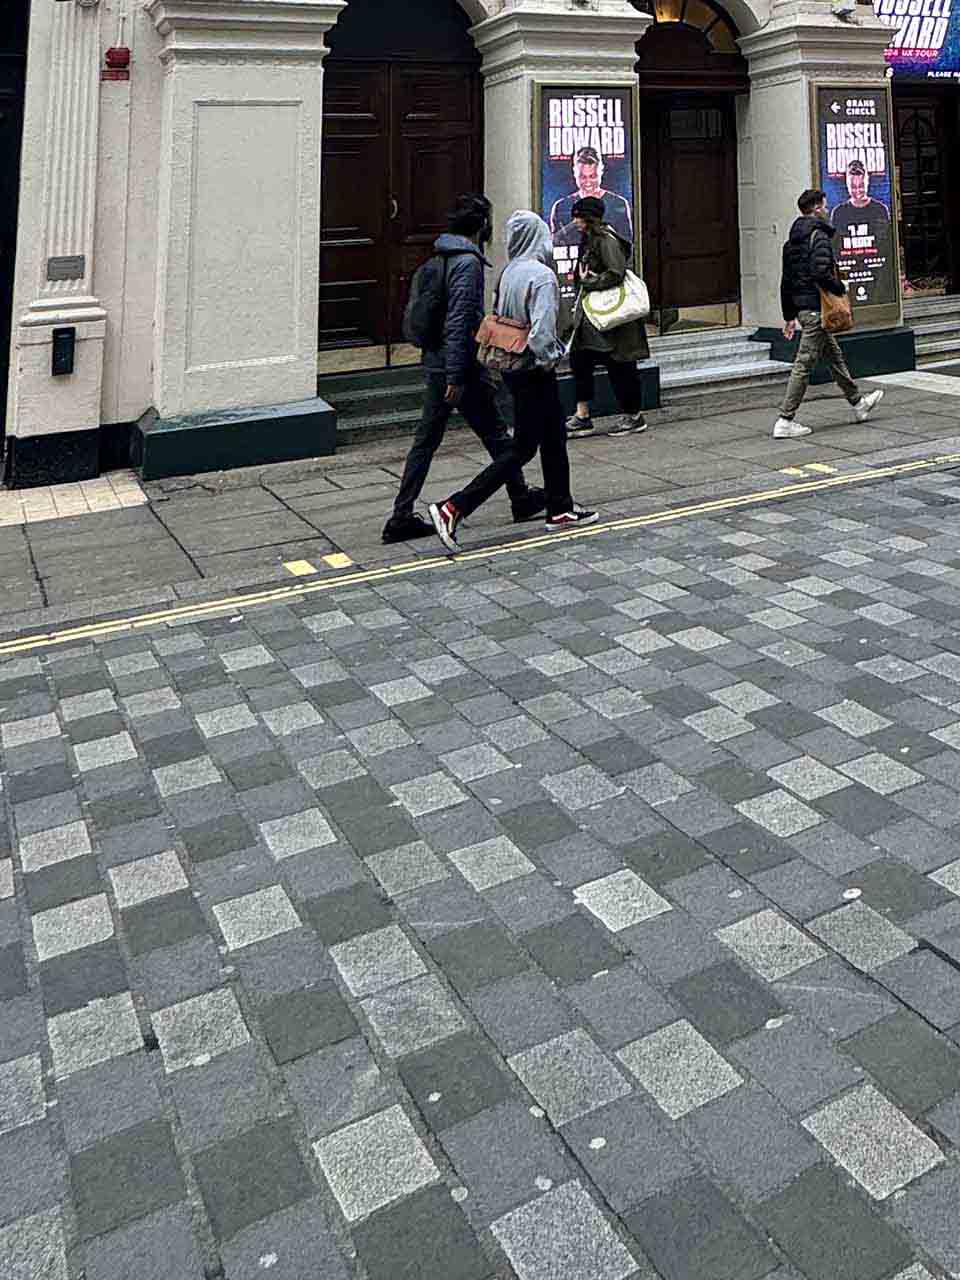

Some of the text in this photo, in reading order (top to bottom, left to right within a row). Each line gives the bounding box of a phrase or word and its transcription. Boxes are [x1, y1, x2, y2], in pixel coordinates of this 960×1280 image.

[549, 98, 625, 127] RUSSELL
[846, 99, 875, 107] GRAND
[846, 107, 876, 116] CIRCLE
[549, 127, 625, 156] HOWARD
[826, 123, 884, 148] RUSSELL
[827, 148, 886, 173] HOWARD
